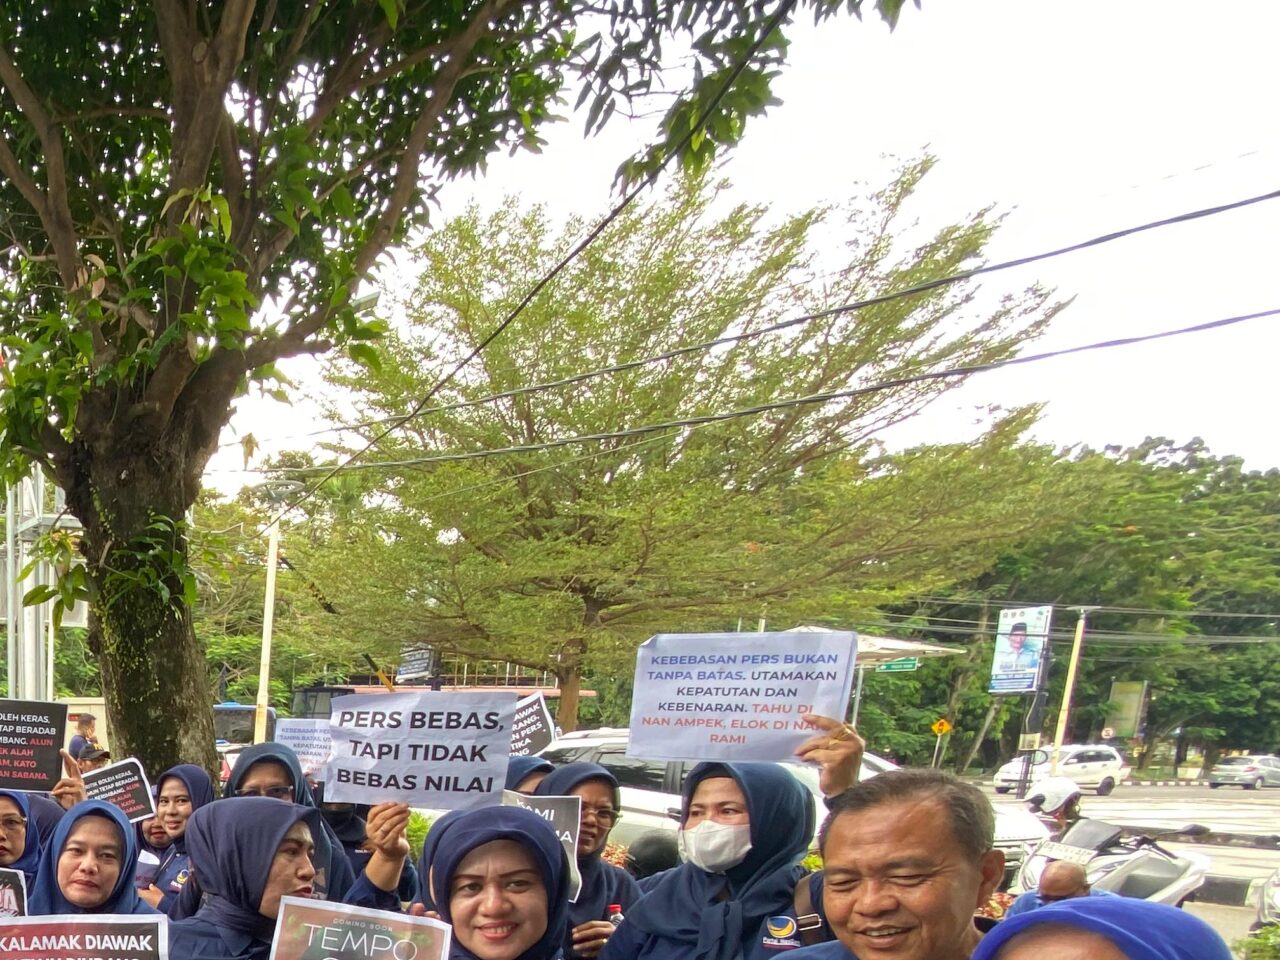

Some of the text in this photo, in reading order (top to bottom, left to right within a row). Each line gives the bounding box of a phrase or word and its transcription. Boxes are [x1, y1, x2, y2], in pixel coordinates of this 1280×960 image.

[651, 655, 838, 664] KEBEBASAN PERS BUKAN
[648, 671, 836, 680] TANPA BATAS. UTAMAKAN
[677, 687, 797, 697] KEPATUTAN DAN
[513, 703, 540, 721] AWAK
[658, 702, 813, 713] KEBENARAN. TAHU DI
[339, 711, 504, 732] PERS BEBAS,
[512, 715, 539, 731] RANG.
[642, 717, 671, 726] NAN
[674, 719, 726, 728] AMPEK,
[731, 720, 768, 729] ELOK
[773, 721, 788, 729] DI
[16, 726, 56, 735] BERADAB
[521, 722, 542, 737] PERS
[30, 738, 53, 746] ALUN
[709, 734, 745, 744] RAMI
[10, 748, 33, 756] ALAH
[349, 740, 400, 760] TAPI
[408, 744, 488, 762] TIDAK
[14, 760, 36, 768] KATO
[337, 769, 493, 792] BEBAS NILAI
[85, 935, 152, 951] DIAWAK
